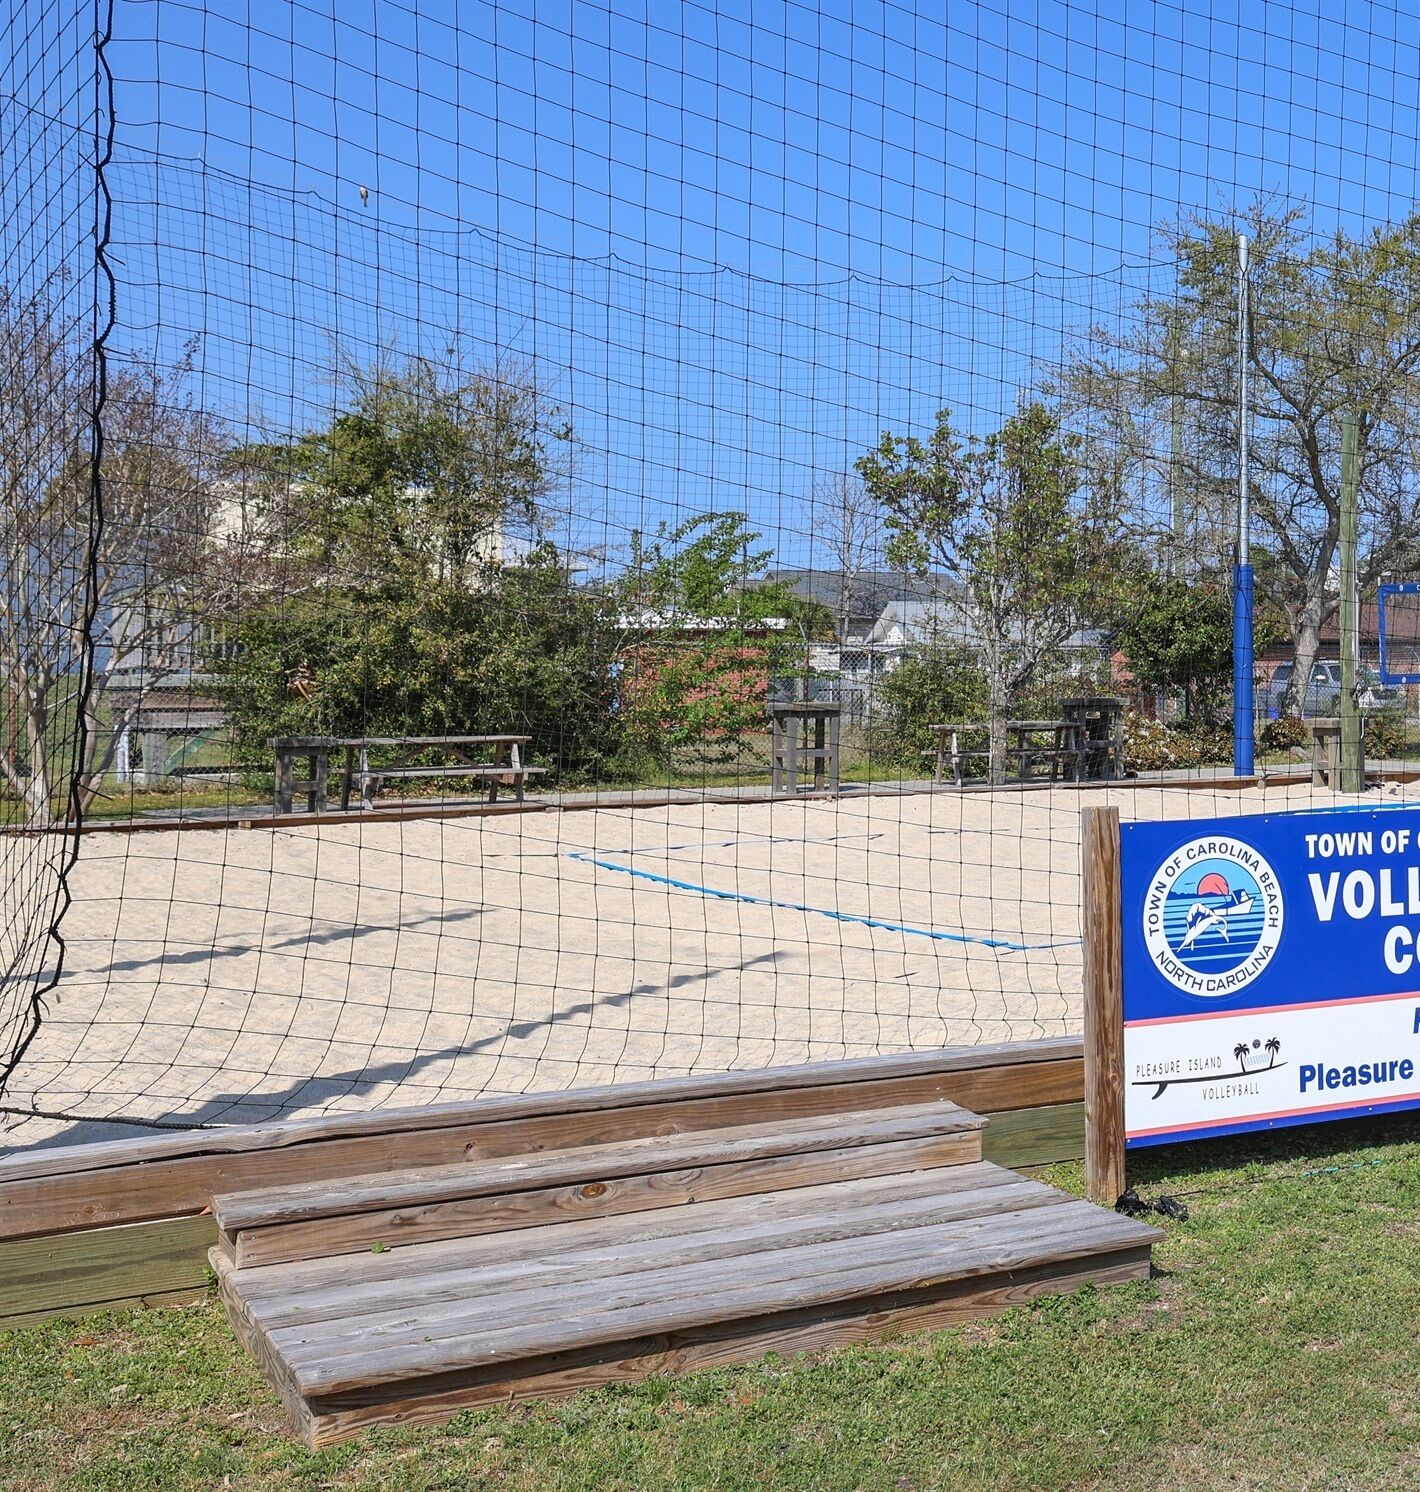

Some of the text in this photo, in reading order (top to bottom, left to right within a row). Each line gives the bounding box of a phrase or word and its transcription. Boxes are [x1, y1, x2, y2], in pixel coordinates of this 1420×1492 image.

[1305, 831, 1373, 858] TOWN
[1380, 829, 1410, 854] OF
[1148, 842, 1279, 937] TOWN OF CAROLINA BEACH
[1155, 945, 1274, 991] NORTH CAROLINA
[1136, 1056, 1222, 1078] PLEASURE ISLAND
[1300, 1058, 1414, 1092] Pleasure
[1202, 1083, 1260, 1100] VOLLEYBALL
